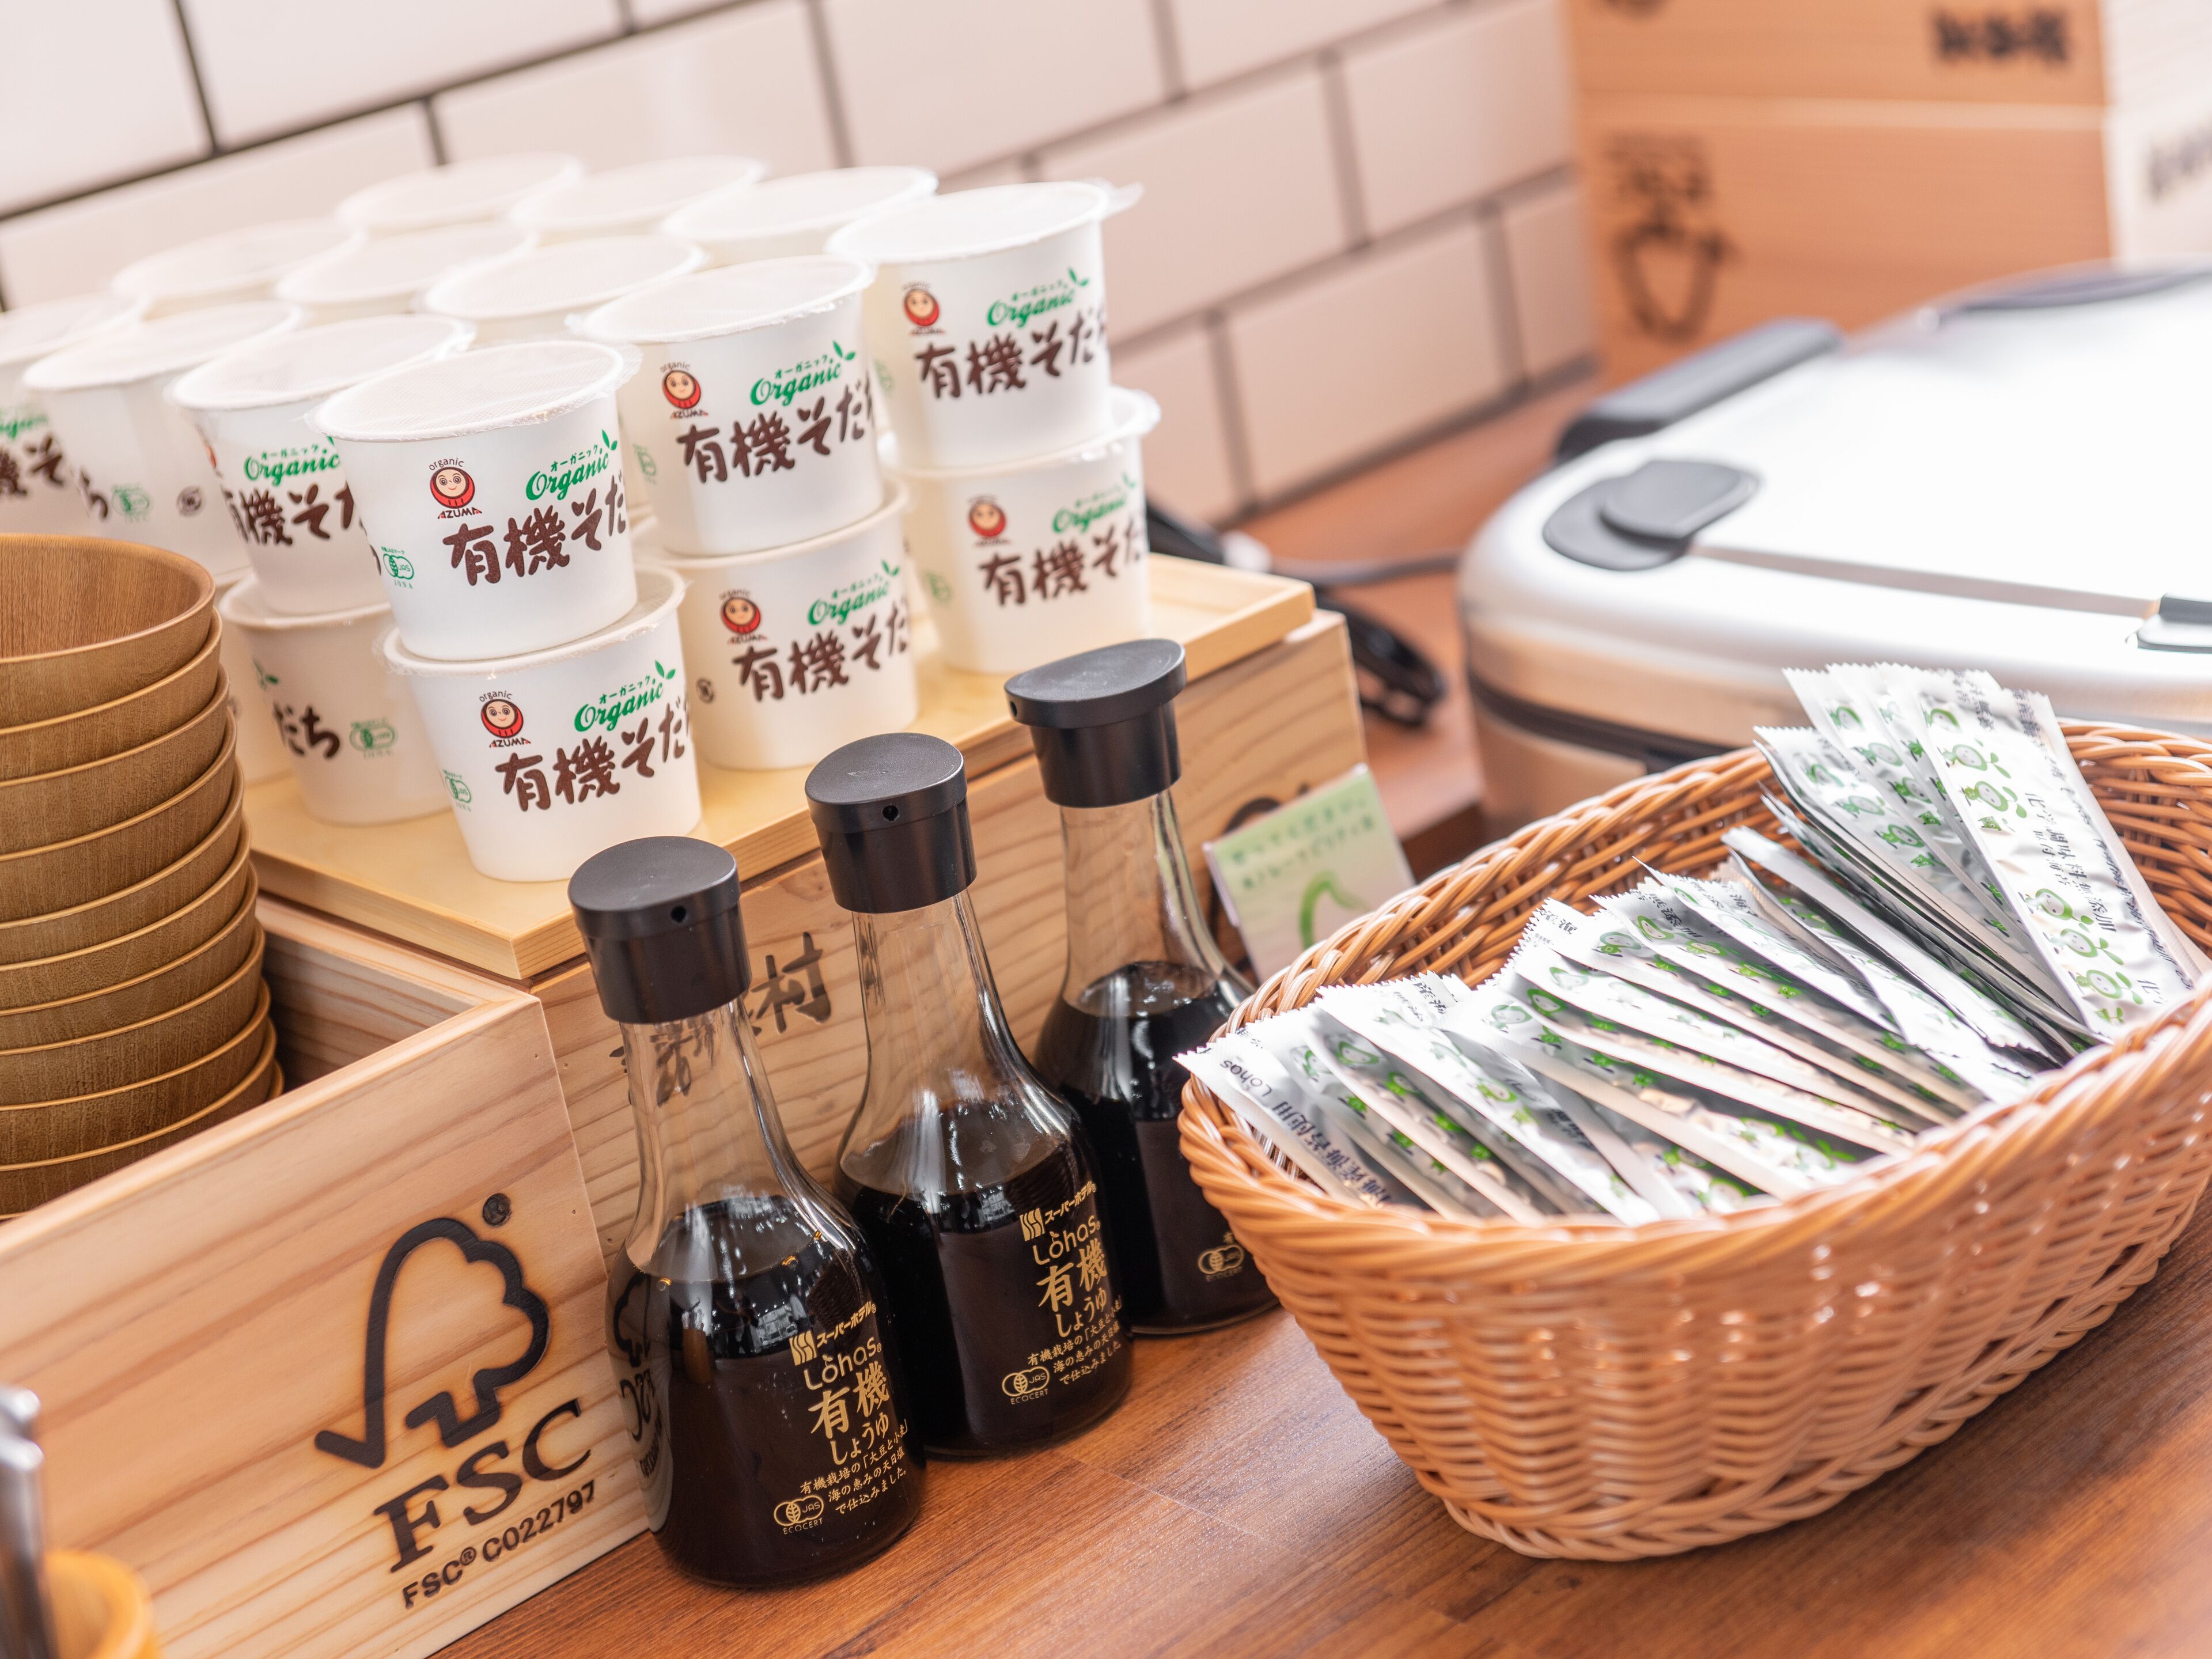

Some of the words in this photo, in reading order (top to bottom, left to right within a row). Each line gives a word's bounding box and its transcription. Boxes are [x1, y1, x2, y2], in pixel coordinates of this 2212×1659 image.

[987, 289, 1074, 328] Organic
[750, 358, 842, 406] Organic
[670, 409, 709, 419] AZUMA
[676, 366, 875, 484] 有機そだ
[244, 448, 341, 487] Organic
[429, 457, 464, 471] organic
[525, 448, 609, 500] Organic
[550, 444, 599, 472] オーガニック
[437, 506, 483, 520] AZUMA
[808, 579, 891, 626] Organic
[479, 690, 512, 702] organic
[574, 678, 664, 732] Organic
[599, 674, 650, 704] オーガニック
[488, 737, 531, 748] AZUMA
[494, 695, 689, 812] 有機そだ
[1036, 1238, 1108, 1313] 有機
[1055, 1287, 1107, 1338] しょうゆ
[808, 1361, 891, 1439] 有機
[1010, 1388, 1049, 1405] ECOCERT
[1029, 1373, 1047, 1384] JAS
[830, 1411, 889, 1466] しょうゆ
[373, 1397, 592, 1574] FSC
[828, 1446, 906, 1503] 海の恵みの天日塩
[482, 1479, 596, 1563] C022797
[782, 1517, 824, 1535] ECOCERT
[801, 1501, 821, 1513] JAS
